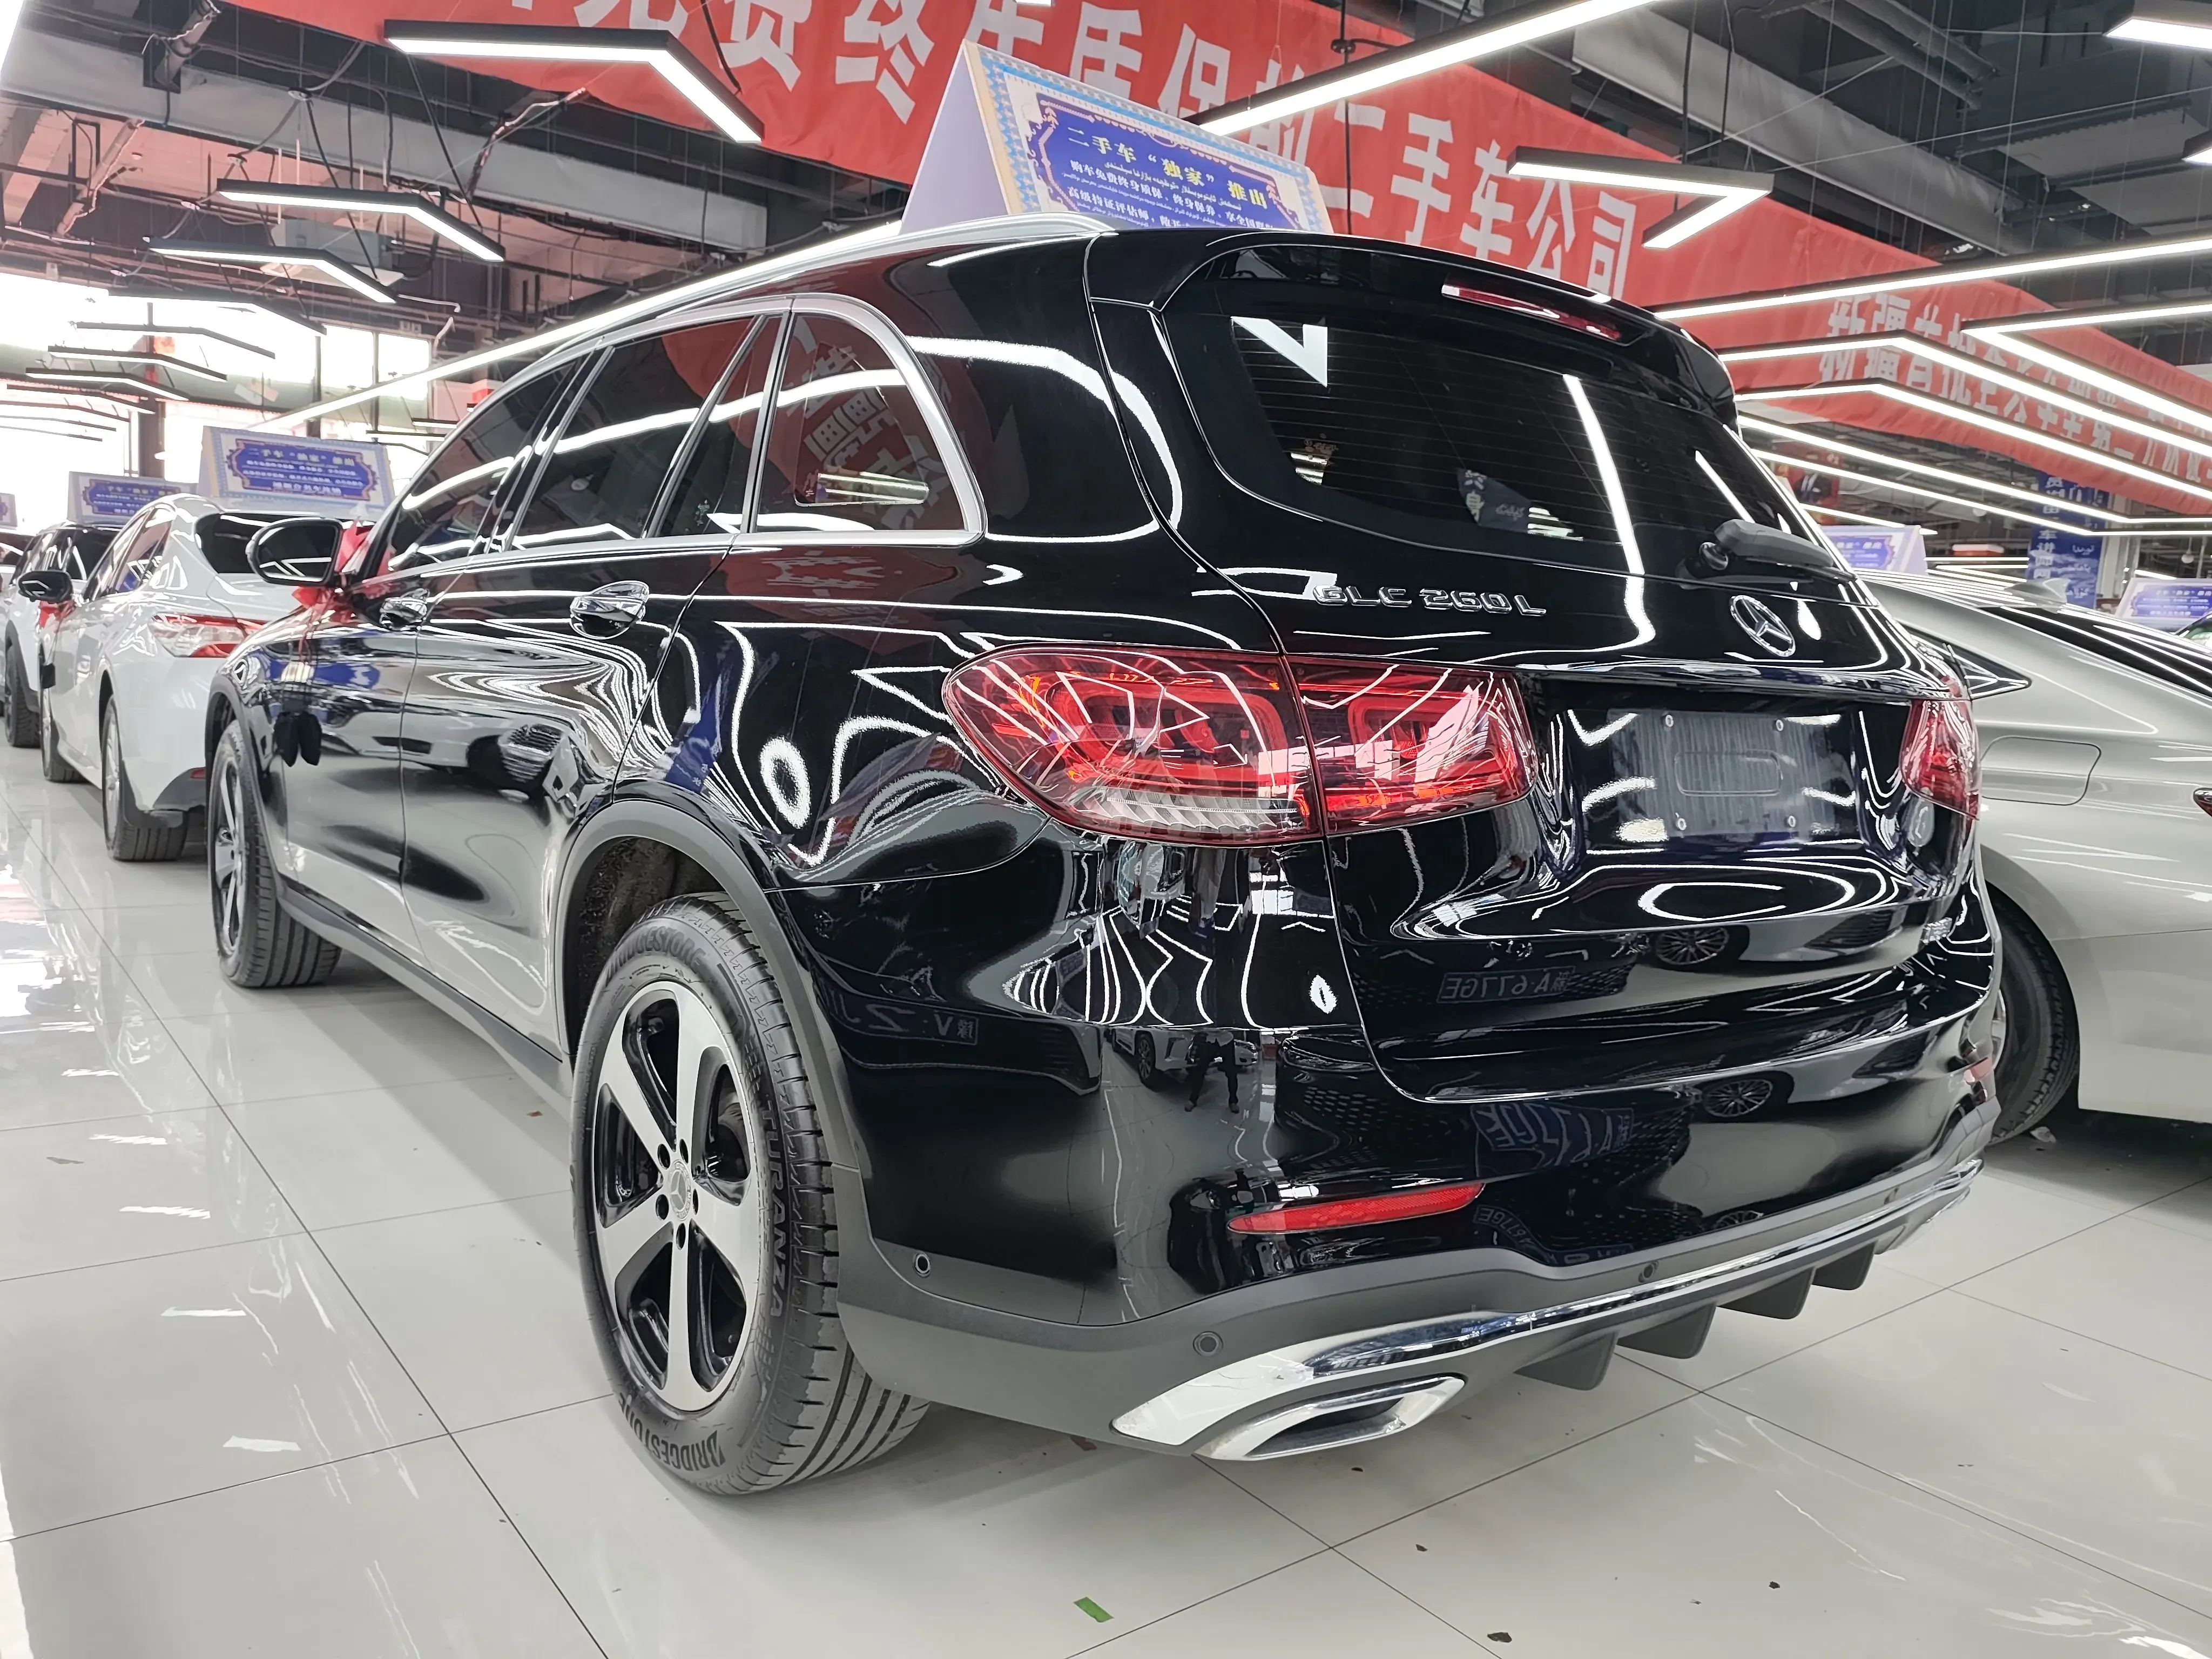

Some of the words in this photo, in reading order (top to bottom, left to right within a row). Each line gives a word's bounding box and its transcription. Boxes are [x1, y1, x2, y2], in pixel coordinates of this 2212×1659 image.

[1068, 126, 1137, 163] 二手车
[1226, 179, 1268, 210] 推出
[1313, 585, 1412, 608] GLC
[761, 1100, 787, 1318] TURANZA
